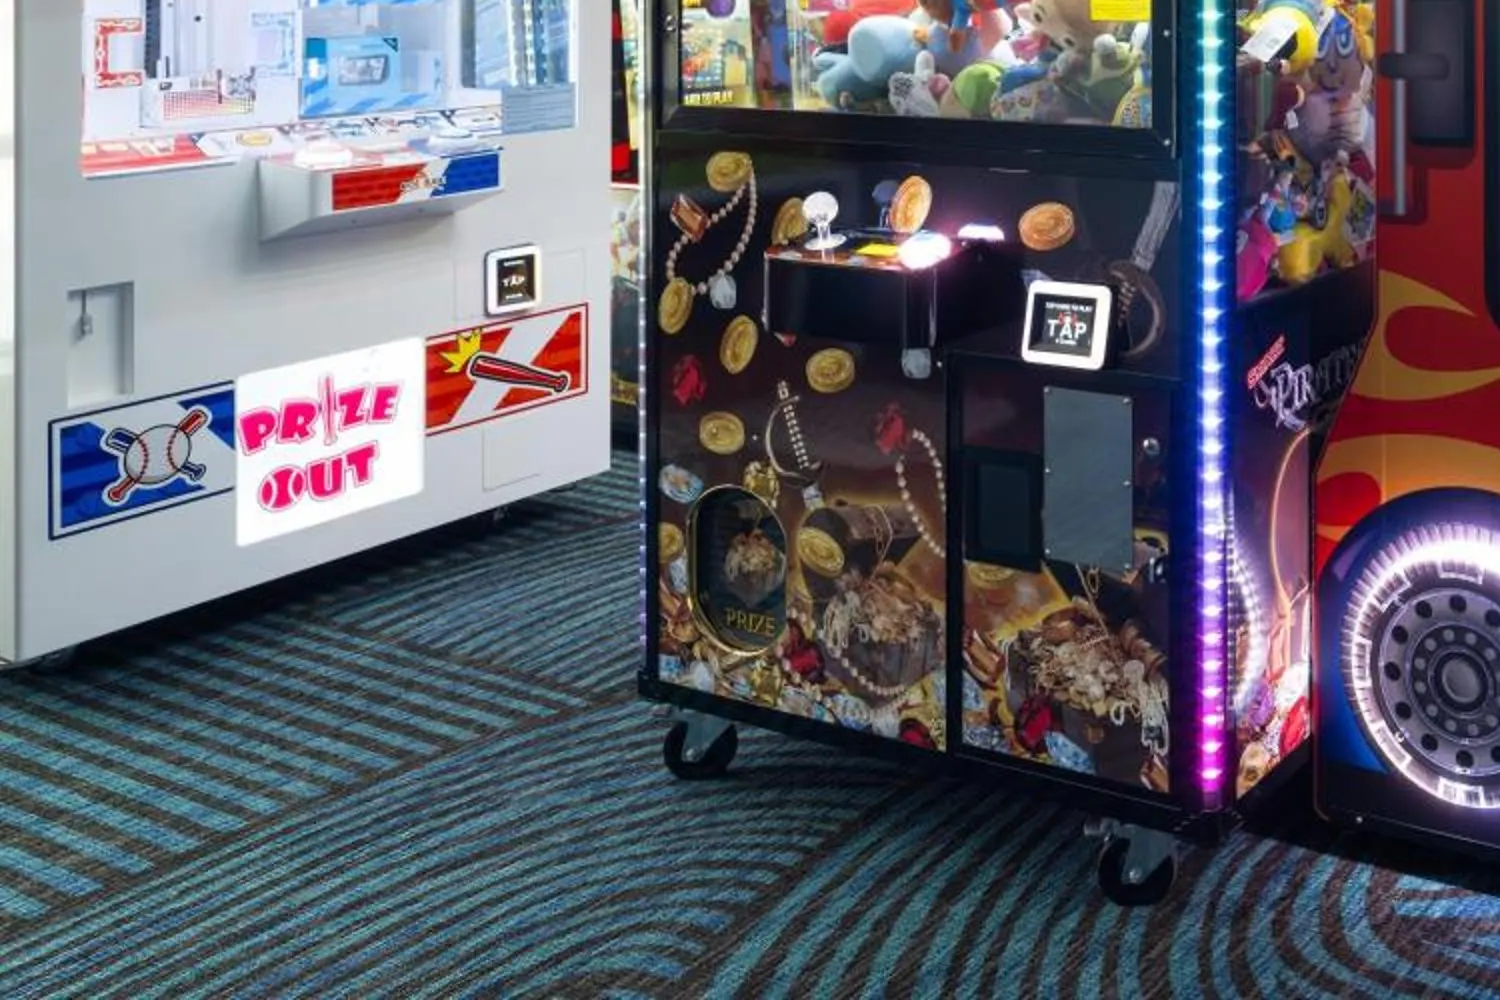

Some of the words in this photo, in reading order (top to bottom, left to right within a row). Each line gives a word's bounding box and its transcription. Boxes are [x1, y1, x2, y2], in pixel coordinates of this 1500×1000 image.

[1047, 318, 1088, 340] TAP
[238, 374, 403, 455] PRIZE
[257, 442, 381, 513] OUT
[724, 606, 776, 637] PRIZE
